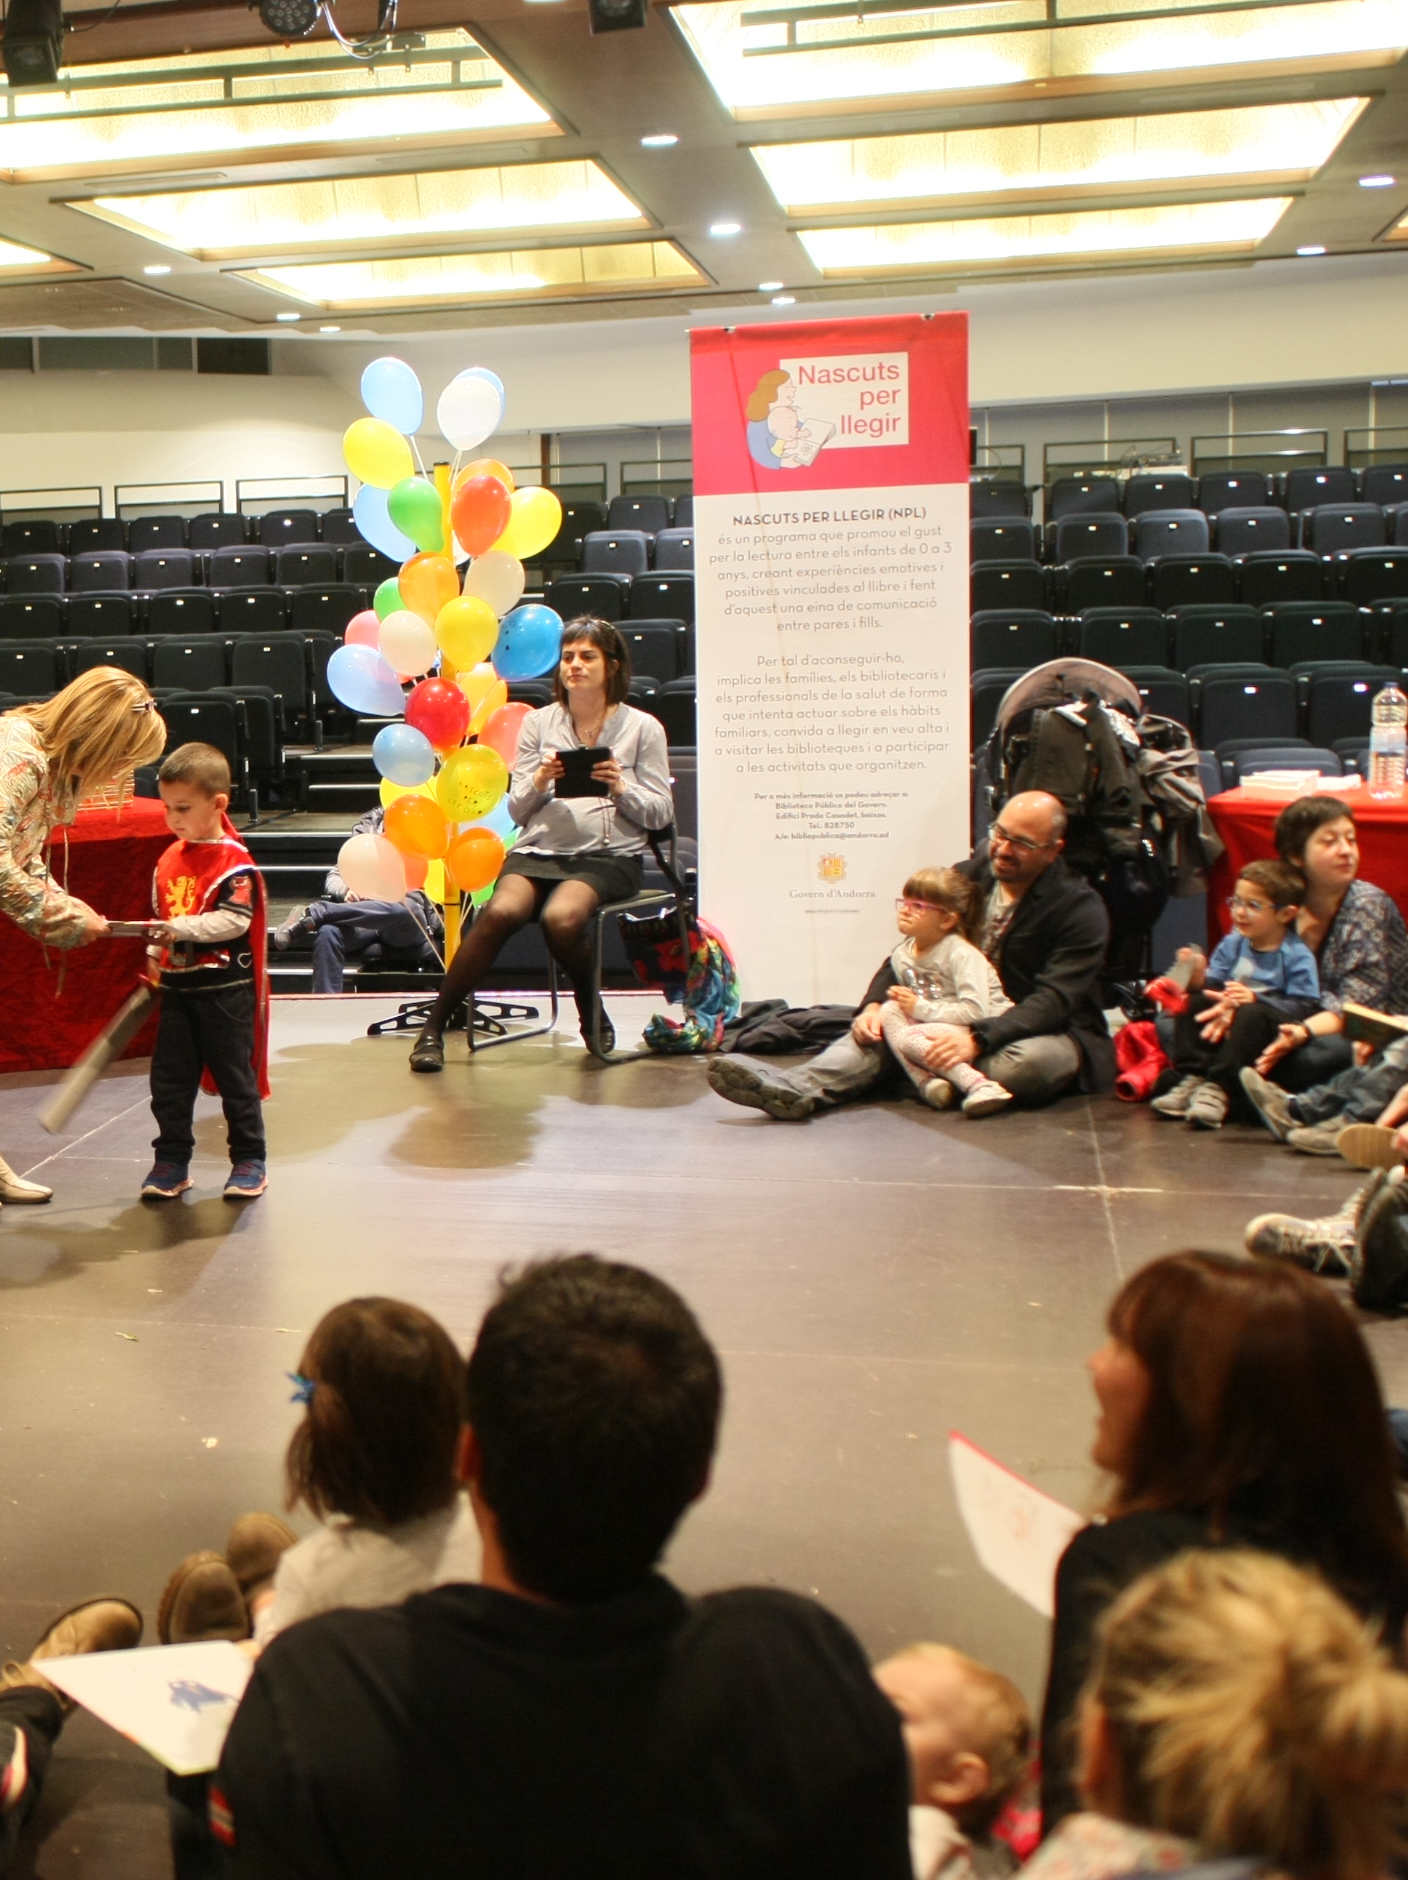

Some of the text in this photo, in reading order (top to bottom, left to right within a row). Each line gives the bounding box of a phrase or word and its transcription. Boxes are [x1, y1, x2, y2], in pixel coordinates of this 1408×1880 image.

[798, 362, 900, 385] Nascuts
[860, 389, 901, 411] per
[841, 413, 901, 438] llegir
[732, 506, 927, 527] NASCUTS PER LLEGIR (NPL)
[718, 525, 942, 545] és un programa que promou el gust
[709, 541, 952, 566] per la lectura entre els infants de 0 a 3
[717, 570, 749, 582] anys,
[752, 567, 793, 579] creant
[796, 564, 876, 579] experiències
[879, 562, 937, 574] emotives
[725, 586, 780, 600] positives
[783, 582, 850, 595] vinculades
[853, 580, 865, 592] al
[868, 580, 900, 592] llibre
[910, 578, 936, 591] fent
[724, 596, 937, 617] d'aquest una eina de comunicació
[777, 620, 811, 631] entre
[813, 619, 850, 632] pares
[859, 616, 883, 629] fills.
[757, 655, 779, 667] Per
[781, 654, 798, 666] tal
[717, 673, 762, 688] implica
[765, 673, 782, 685] les
[785, 671, 837, 685] famílies,
[839, 670, 857, 683] els
[860, 669, 939, 682] bibliotecaris
[715, 685, 948, 705] els professionals de la salut de forma
[722, 704, 941, 723] que intenta actuar sobre els hàbits
[715, 726, 771, 740] familiars,
[774, 725, 823, 737] convida
[826, 727, 835, 736] a
[838, 723, 870, 737] llegir
[873, 726, 889, 735] en
[891, 724, 915, 734] veu
[917, 722, 943, 734] alta
[714, 747, 723, 756] a
[725, 744, 764, 756] visitar
[766, 743, 784, 754] les
[787, 741, 865, 756] biblioteques
[874, 744, 883, 753] a
[886, 741, 950, 755] participar
[736, 760, 928, 774] a les activitats que organitzen.
[775, 802, 813, 810] Biblioteca
[814, 801, 842, 809] Pública
[789, 890, 824, 899] Govern
